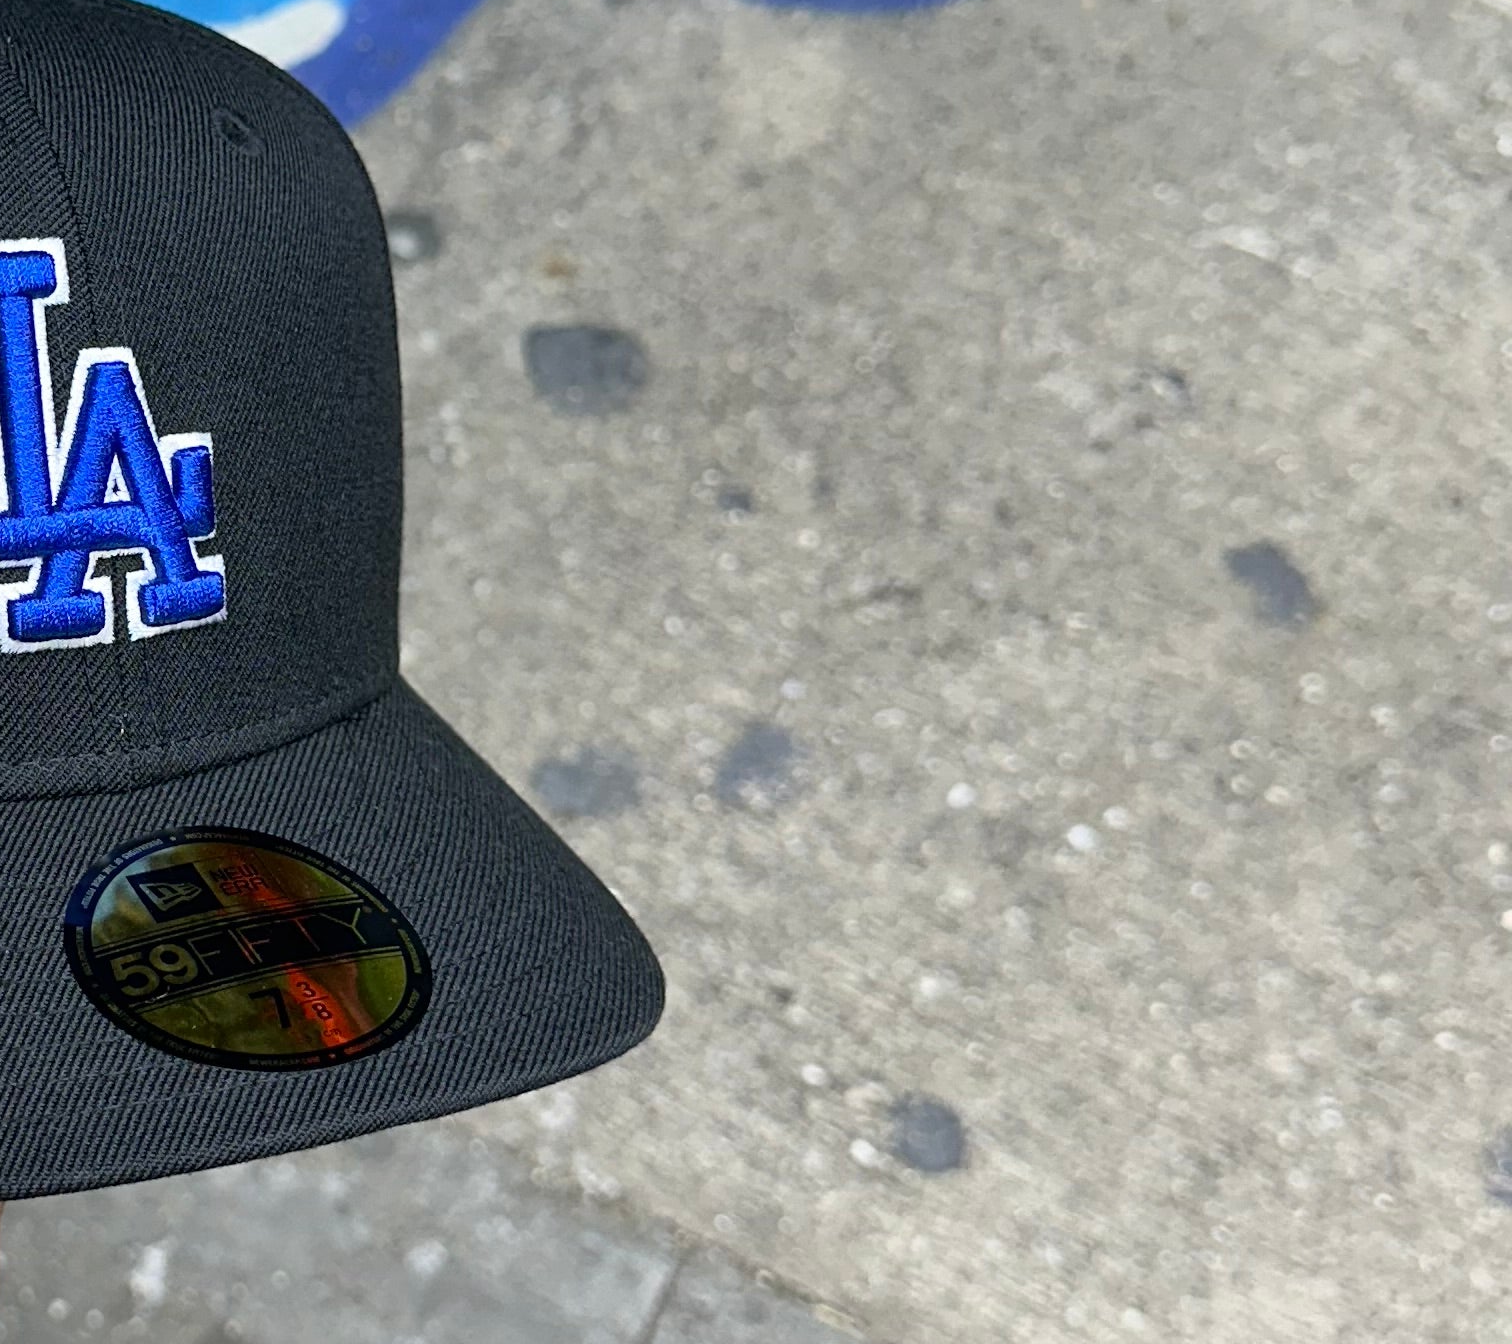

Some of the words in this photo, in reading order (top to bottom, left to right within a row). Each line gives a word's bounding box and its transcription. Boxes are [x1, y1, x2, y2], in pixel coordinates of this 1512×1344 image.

[209, 863, 258, 884] NEW
[219, 876, 270, 896] ERA
[109, 908, 368, 997] 59FIFTY
[248, 987, 292, 1029] 7
